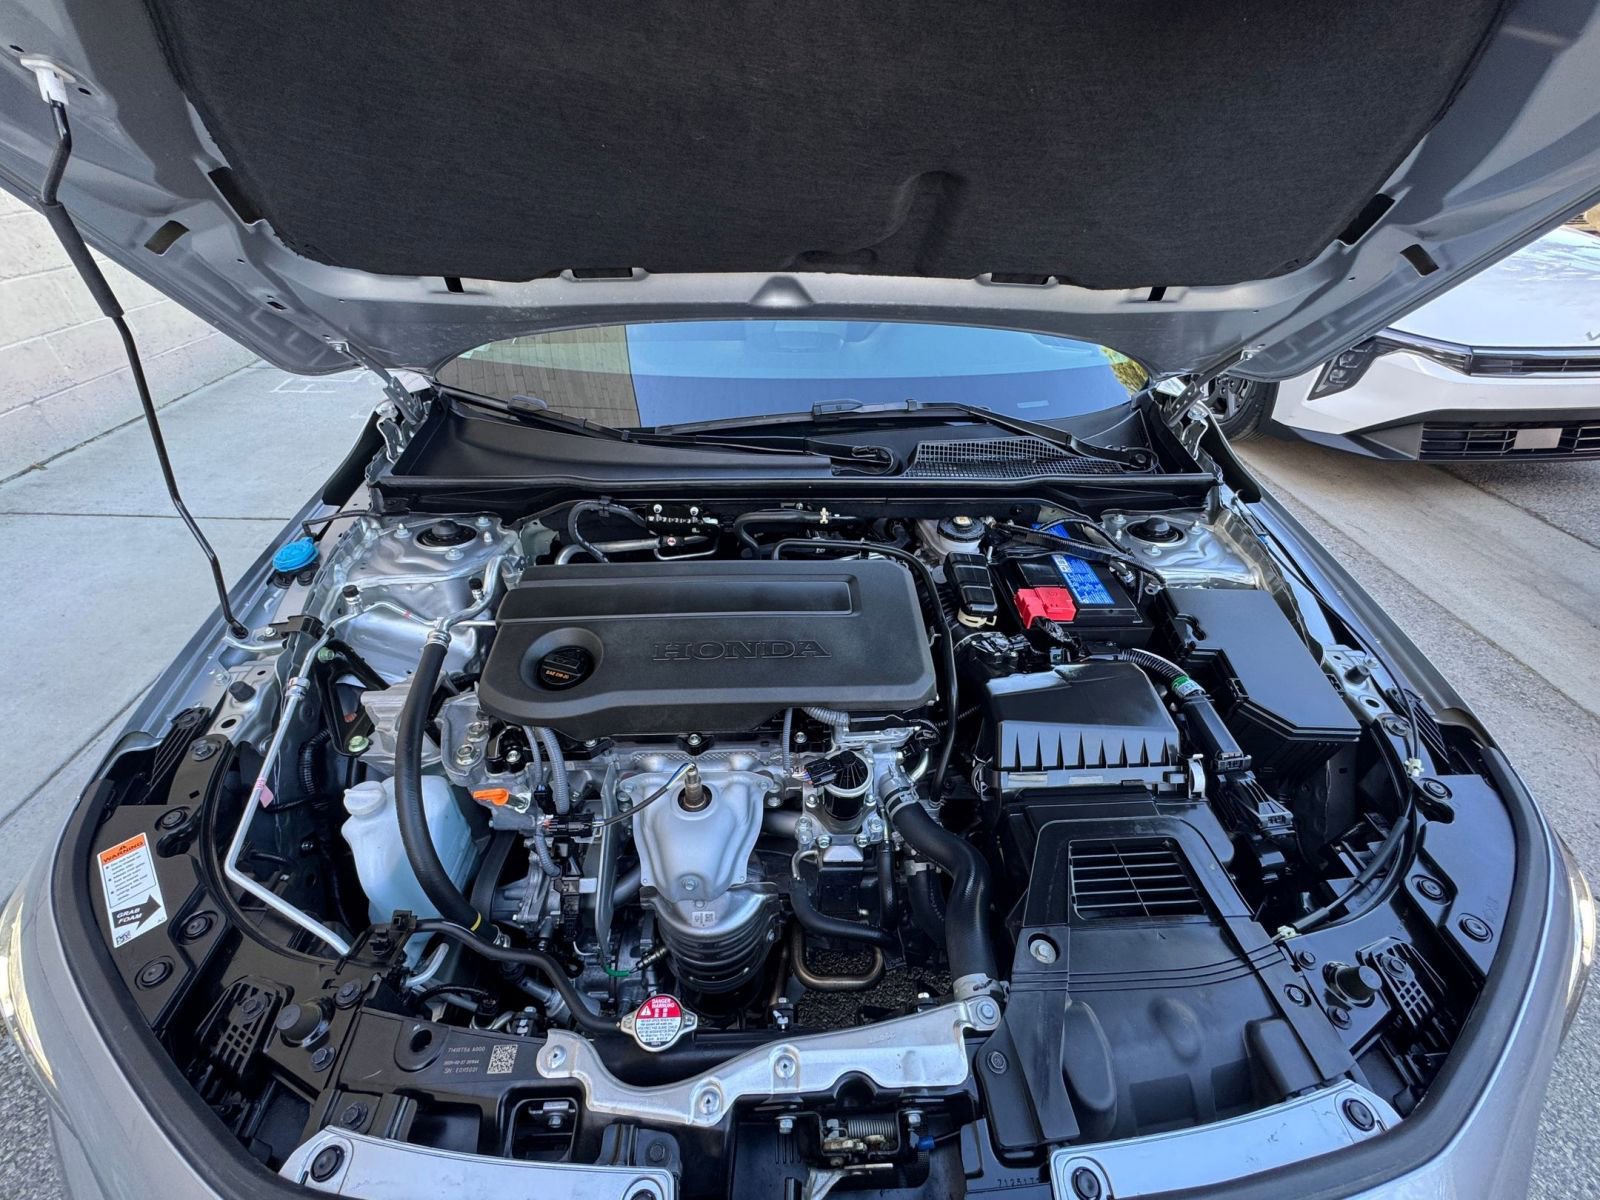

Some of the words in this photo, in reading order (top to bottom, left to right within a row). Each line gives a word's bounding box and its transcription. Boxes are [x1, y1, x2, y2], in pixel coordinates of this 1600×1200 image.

[653, 639, 832, 661] HONDA
[103, 841, 144, 863] WARNING
[116, 907, 140, 919] GRAB
[117, 912, 143, 925] FOAM
